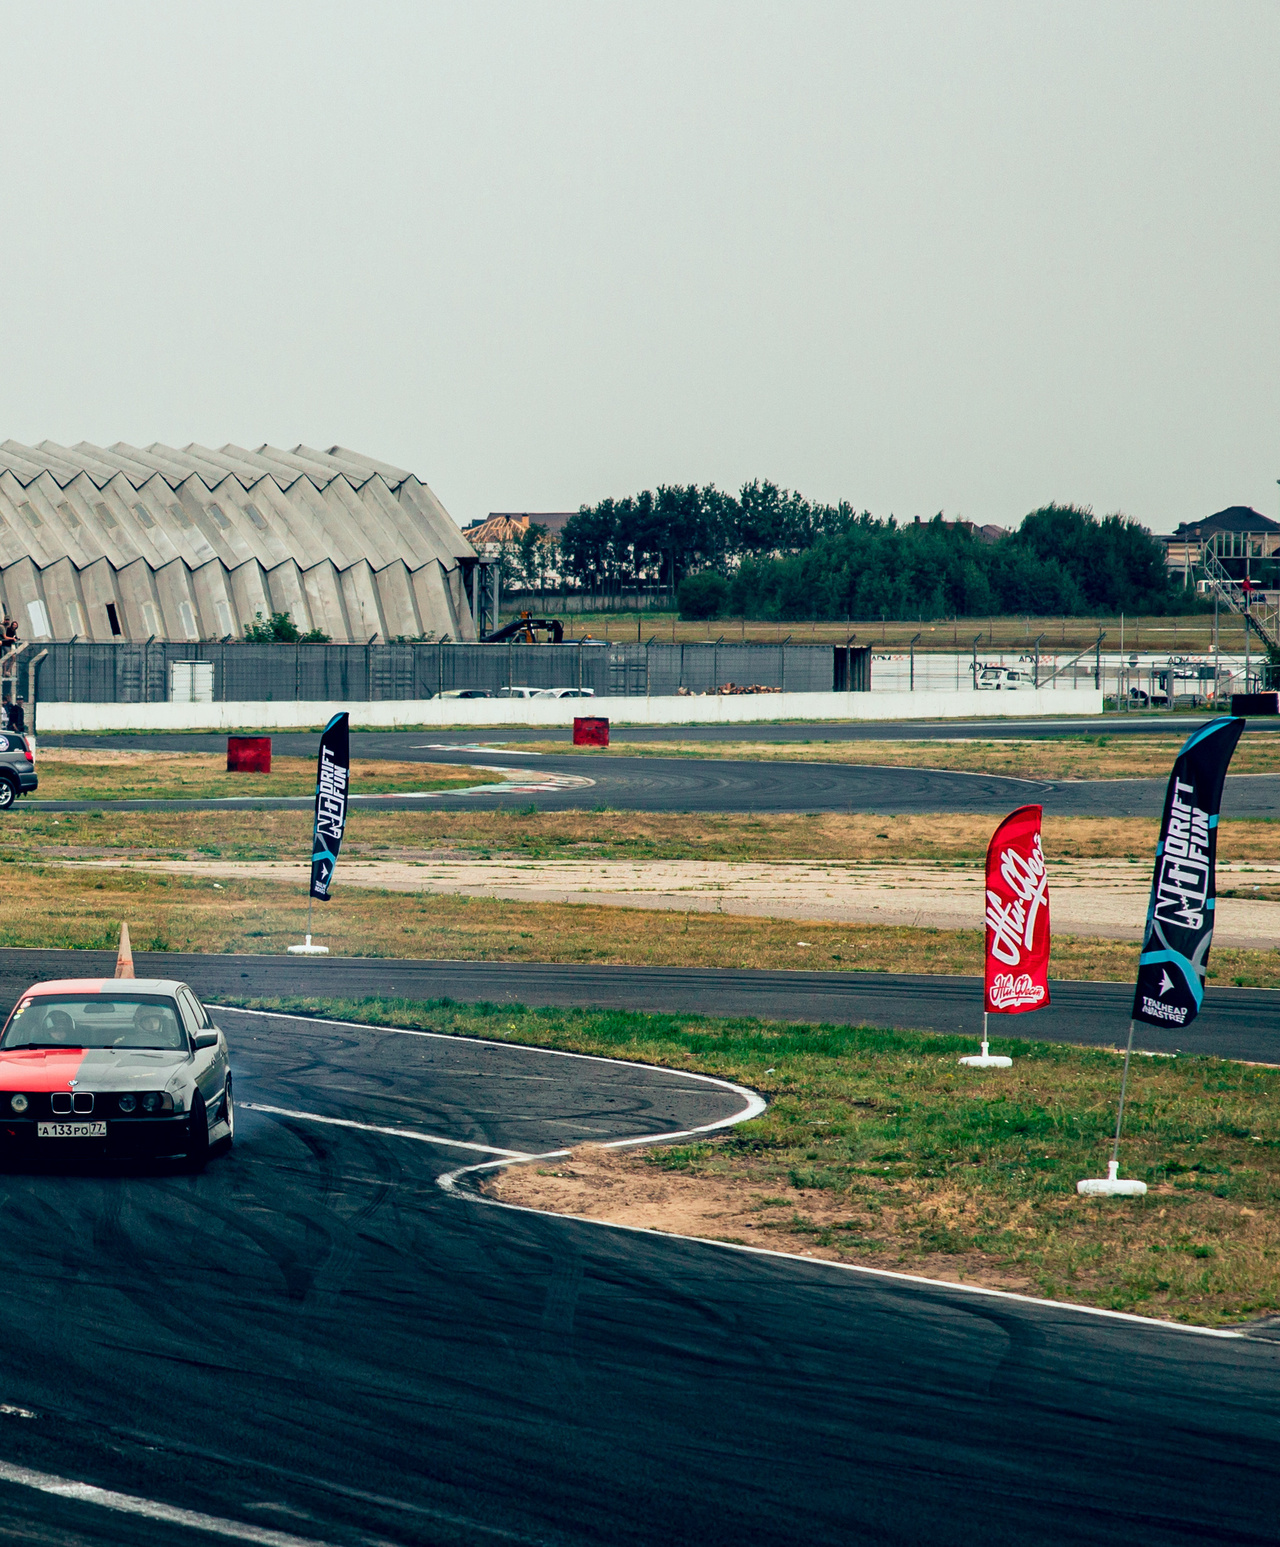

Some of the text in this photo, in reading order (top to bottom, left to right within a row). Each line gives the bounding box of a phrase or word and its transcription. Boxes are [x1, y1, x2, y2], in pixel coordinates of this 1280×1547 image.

[319, 745, 335, 796] DRIFT
[333, 766, 347, 800] FUN
[1164, 776, 1194, 858] DRIFT
[1188, 807, 1210, 864] FUN
[91, 1123, 103, 1133] 77
